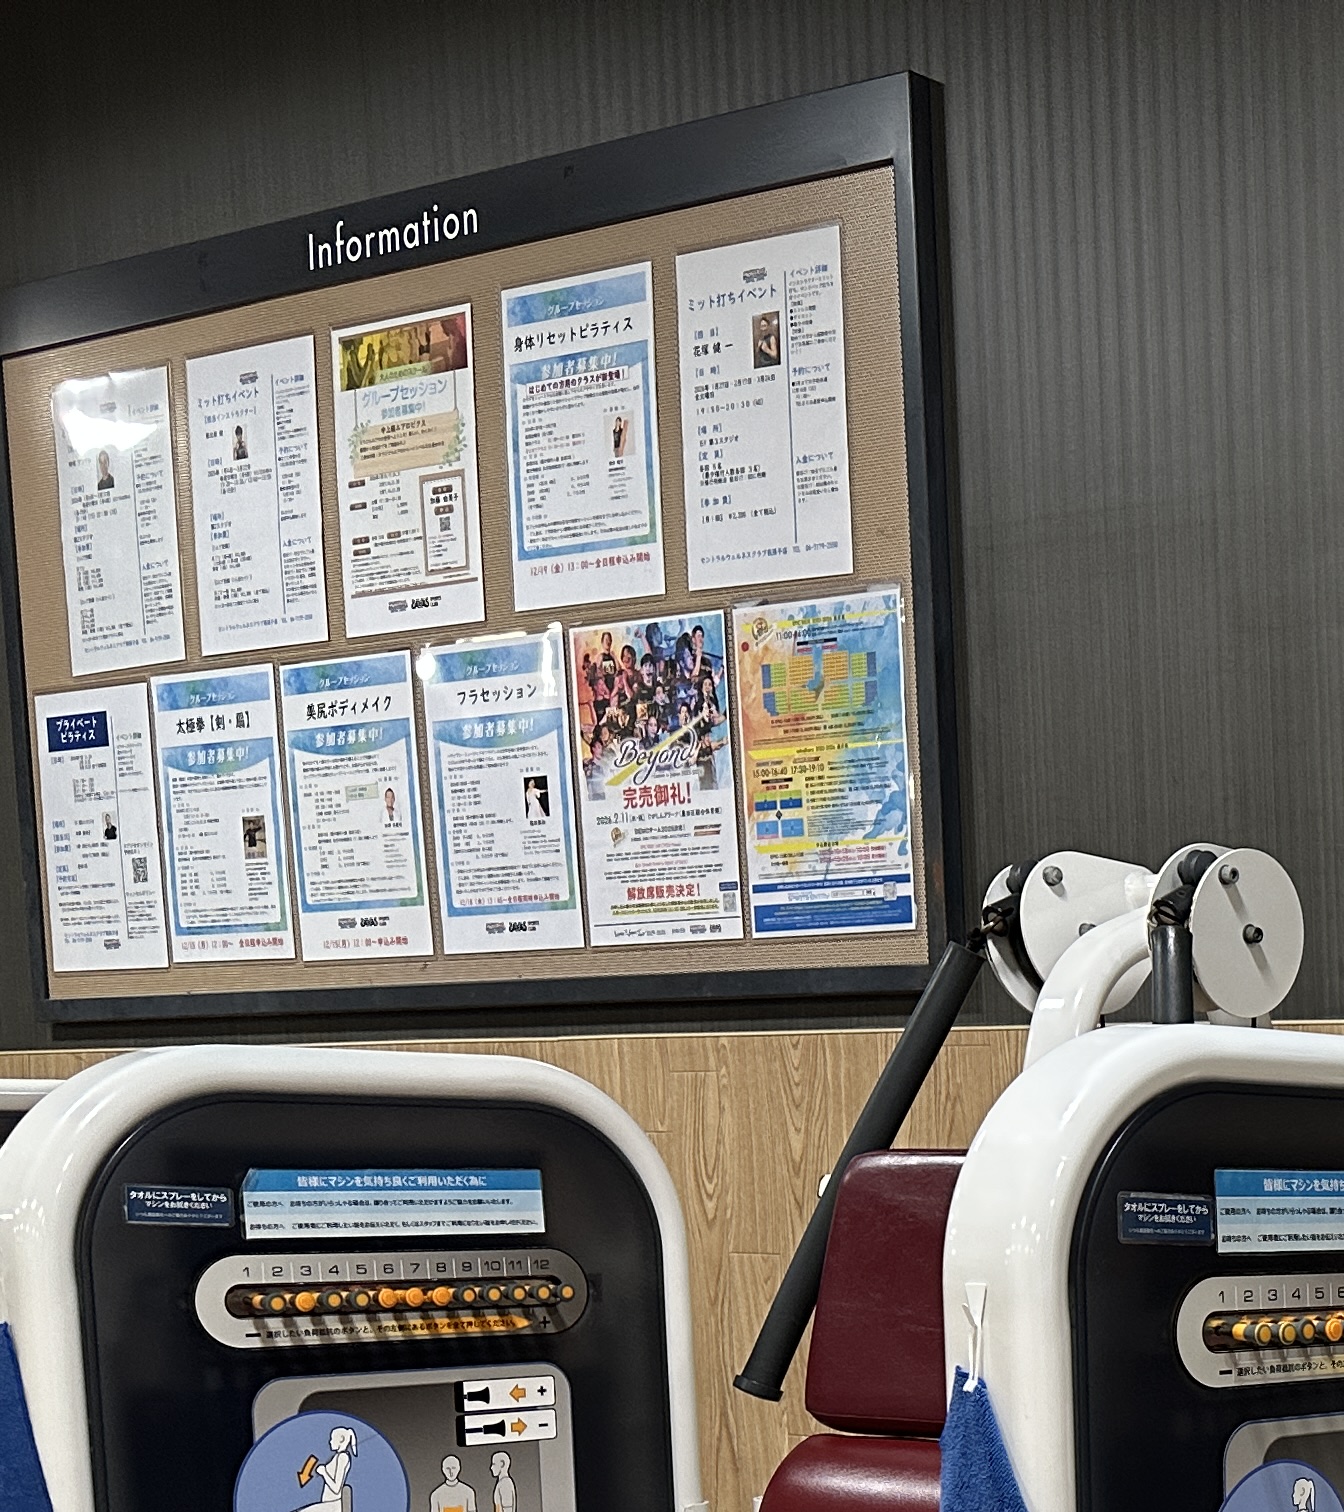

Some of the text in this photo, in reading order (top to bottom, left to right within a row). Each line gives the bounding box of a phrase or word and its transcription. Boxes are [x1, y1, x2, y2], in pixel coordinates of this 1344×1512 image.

[308, 204, 478, 271] Information
[688, 284, 777, 311] ミット打ちイベント
[514, 317, 633, 352] 身体リセットピラティス
[362, 379, 448, 408] グループセッション
[457, 684, 537, 705] フラセッション
[306, 696, 392, 721] 美尻ボディメイク
[56, 716, 97, 731] プライベート
[60, 729, 96, 743] ピラティス
[614, 727, 698, 785] Beyond
[129, 1190, 228, 1202] タオルにスプレーをしてから
[243, 1259, 550, 1277] 1 2 3 4 5 6 7 8 9 10 11 12
[1219, 1291, 1225, 1303] 1
[1243, 1290, 1254, 1302] 2
[1268, 1289, 1278, 1301] 3
[1292, 1288, 1301, 1300] 4
[1315, 1287, 1325, 1299] 5
